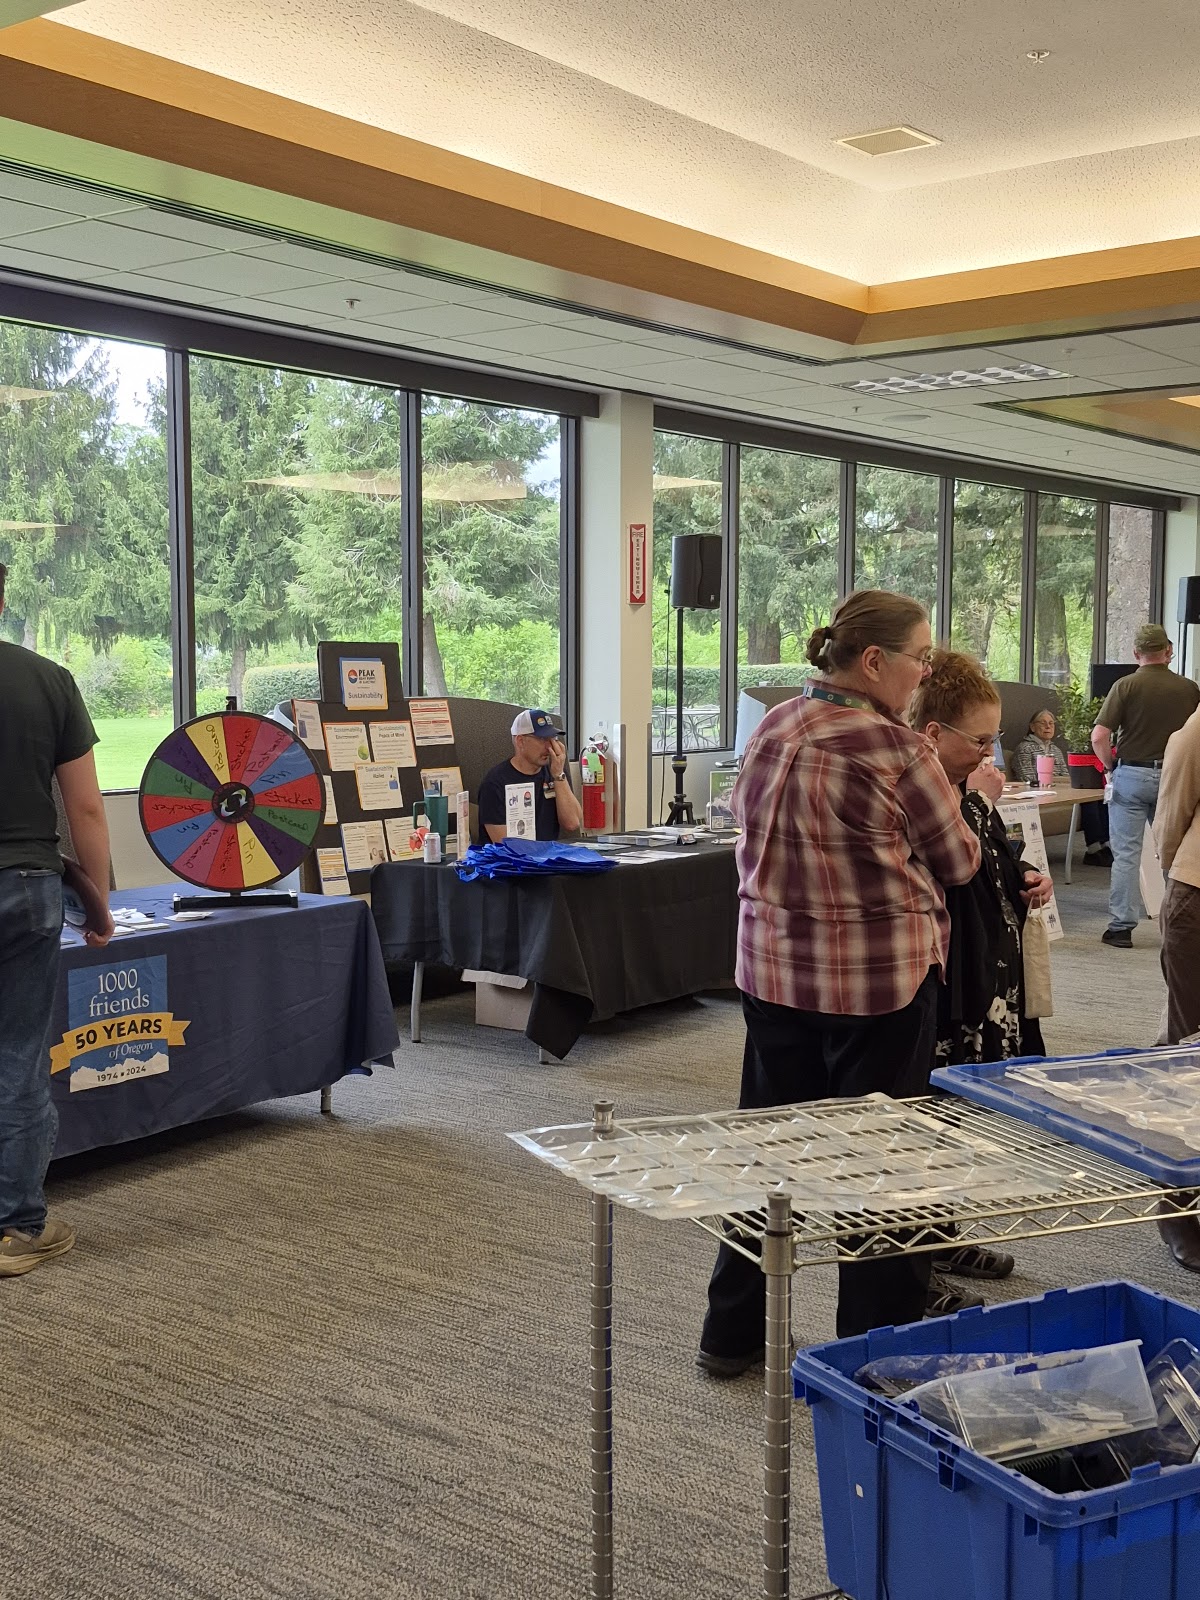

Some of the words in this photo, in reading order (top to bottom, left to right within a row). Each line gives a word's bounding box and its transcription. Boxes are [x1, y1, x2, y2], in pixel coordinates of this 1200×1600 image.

[358, 669, 375, 677] PEAK
[231, 729, 252, 771] Sticker
[175, 773, 193, 795] Pin
[259, 770, 291, 784] Pin
[264, 791, 314, 805] Sticker
[152, 803, 205, 814] Sticker
[178, 822, 200, 834] Pin
[243, 837, 256, 865] Pin
[98, 968, 138, 994] 1000
[89, 987, 150, 1017] friends
[75, 1029, 98, 1050] 50
[102, 1018, 162, 1040] YEARS
[108, 1048, 120, 1060] of
[120, 1042, 154, 1056] Oregon
[97, 1072, 119, 1082] 1974
[126, 1065, 147, 1076] 2024
